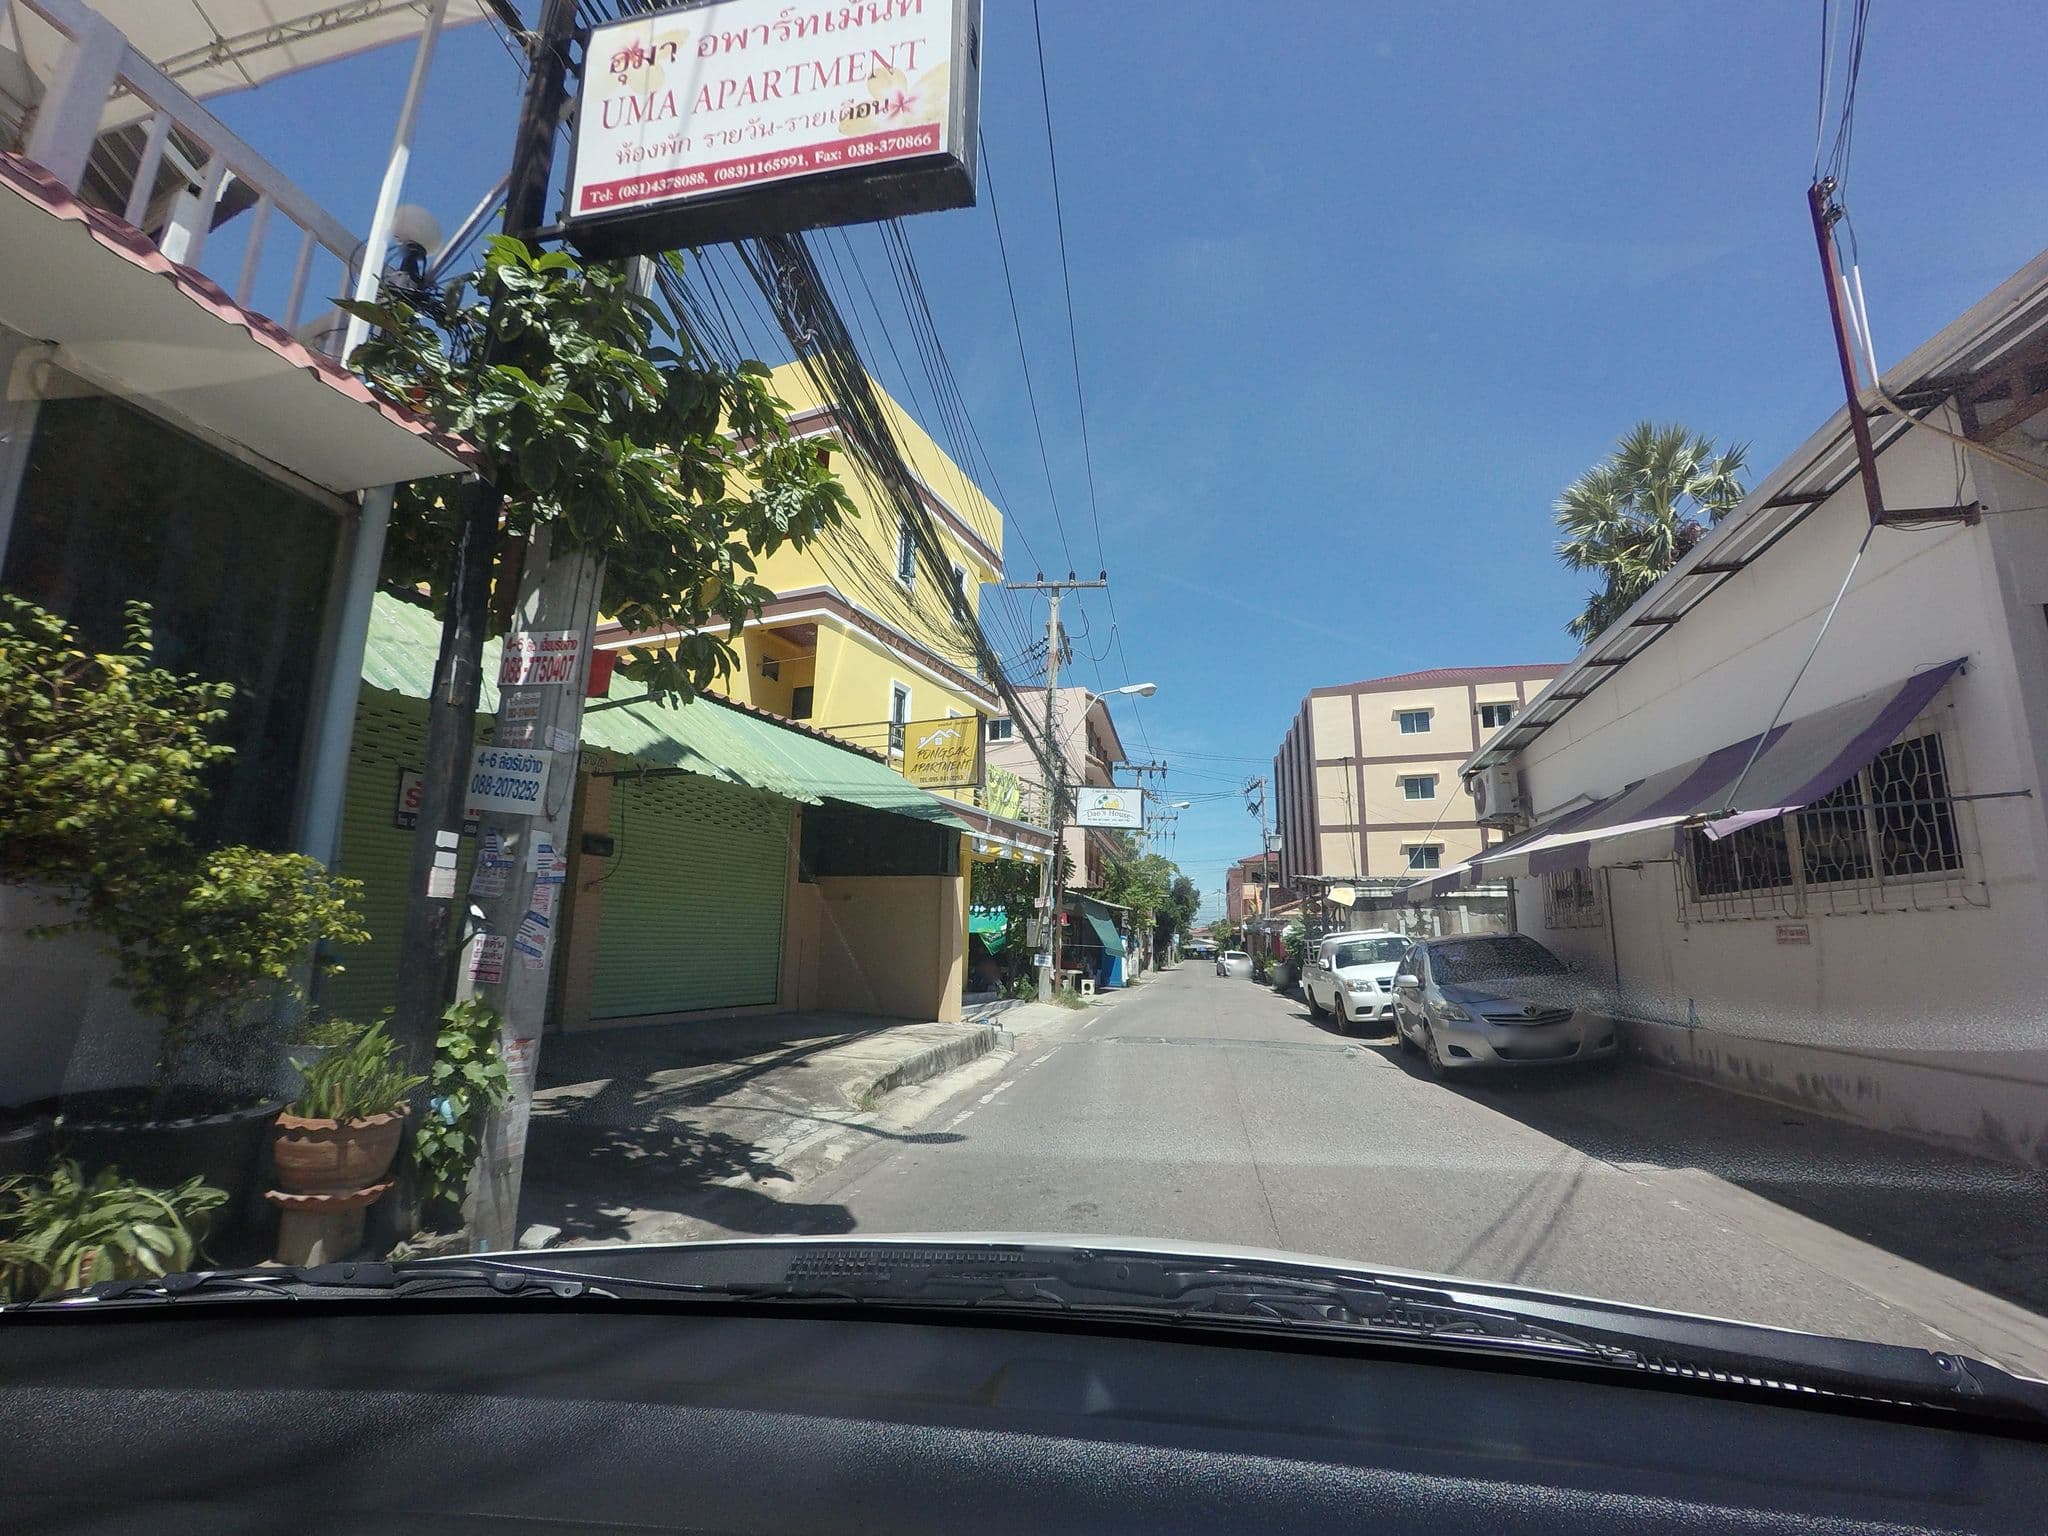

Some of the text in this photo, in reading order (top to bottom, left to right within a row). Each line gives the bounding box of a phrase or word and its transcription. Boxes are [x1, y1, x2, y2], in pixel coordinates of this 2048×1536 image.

[608, 0, 925, 85] อุมา อพาร์ทเม้นท
[601, 38, 927, 131] UMA APARTMENT
[614, 132, 692, 166] ห้องพัก
[590, 132, 933, 204] Tel: (081)4378088, (083)1165991, Fax: 038-370866
[478, 751, 498, 768] 4-6
[909, 758, 974, 774] APARTMENT
[916, 745, 970, 762] PONGSAK
[471, 774, 541, 802] 088-2073252
[1109, 810, 1131, 819] House
